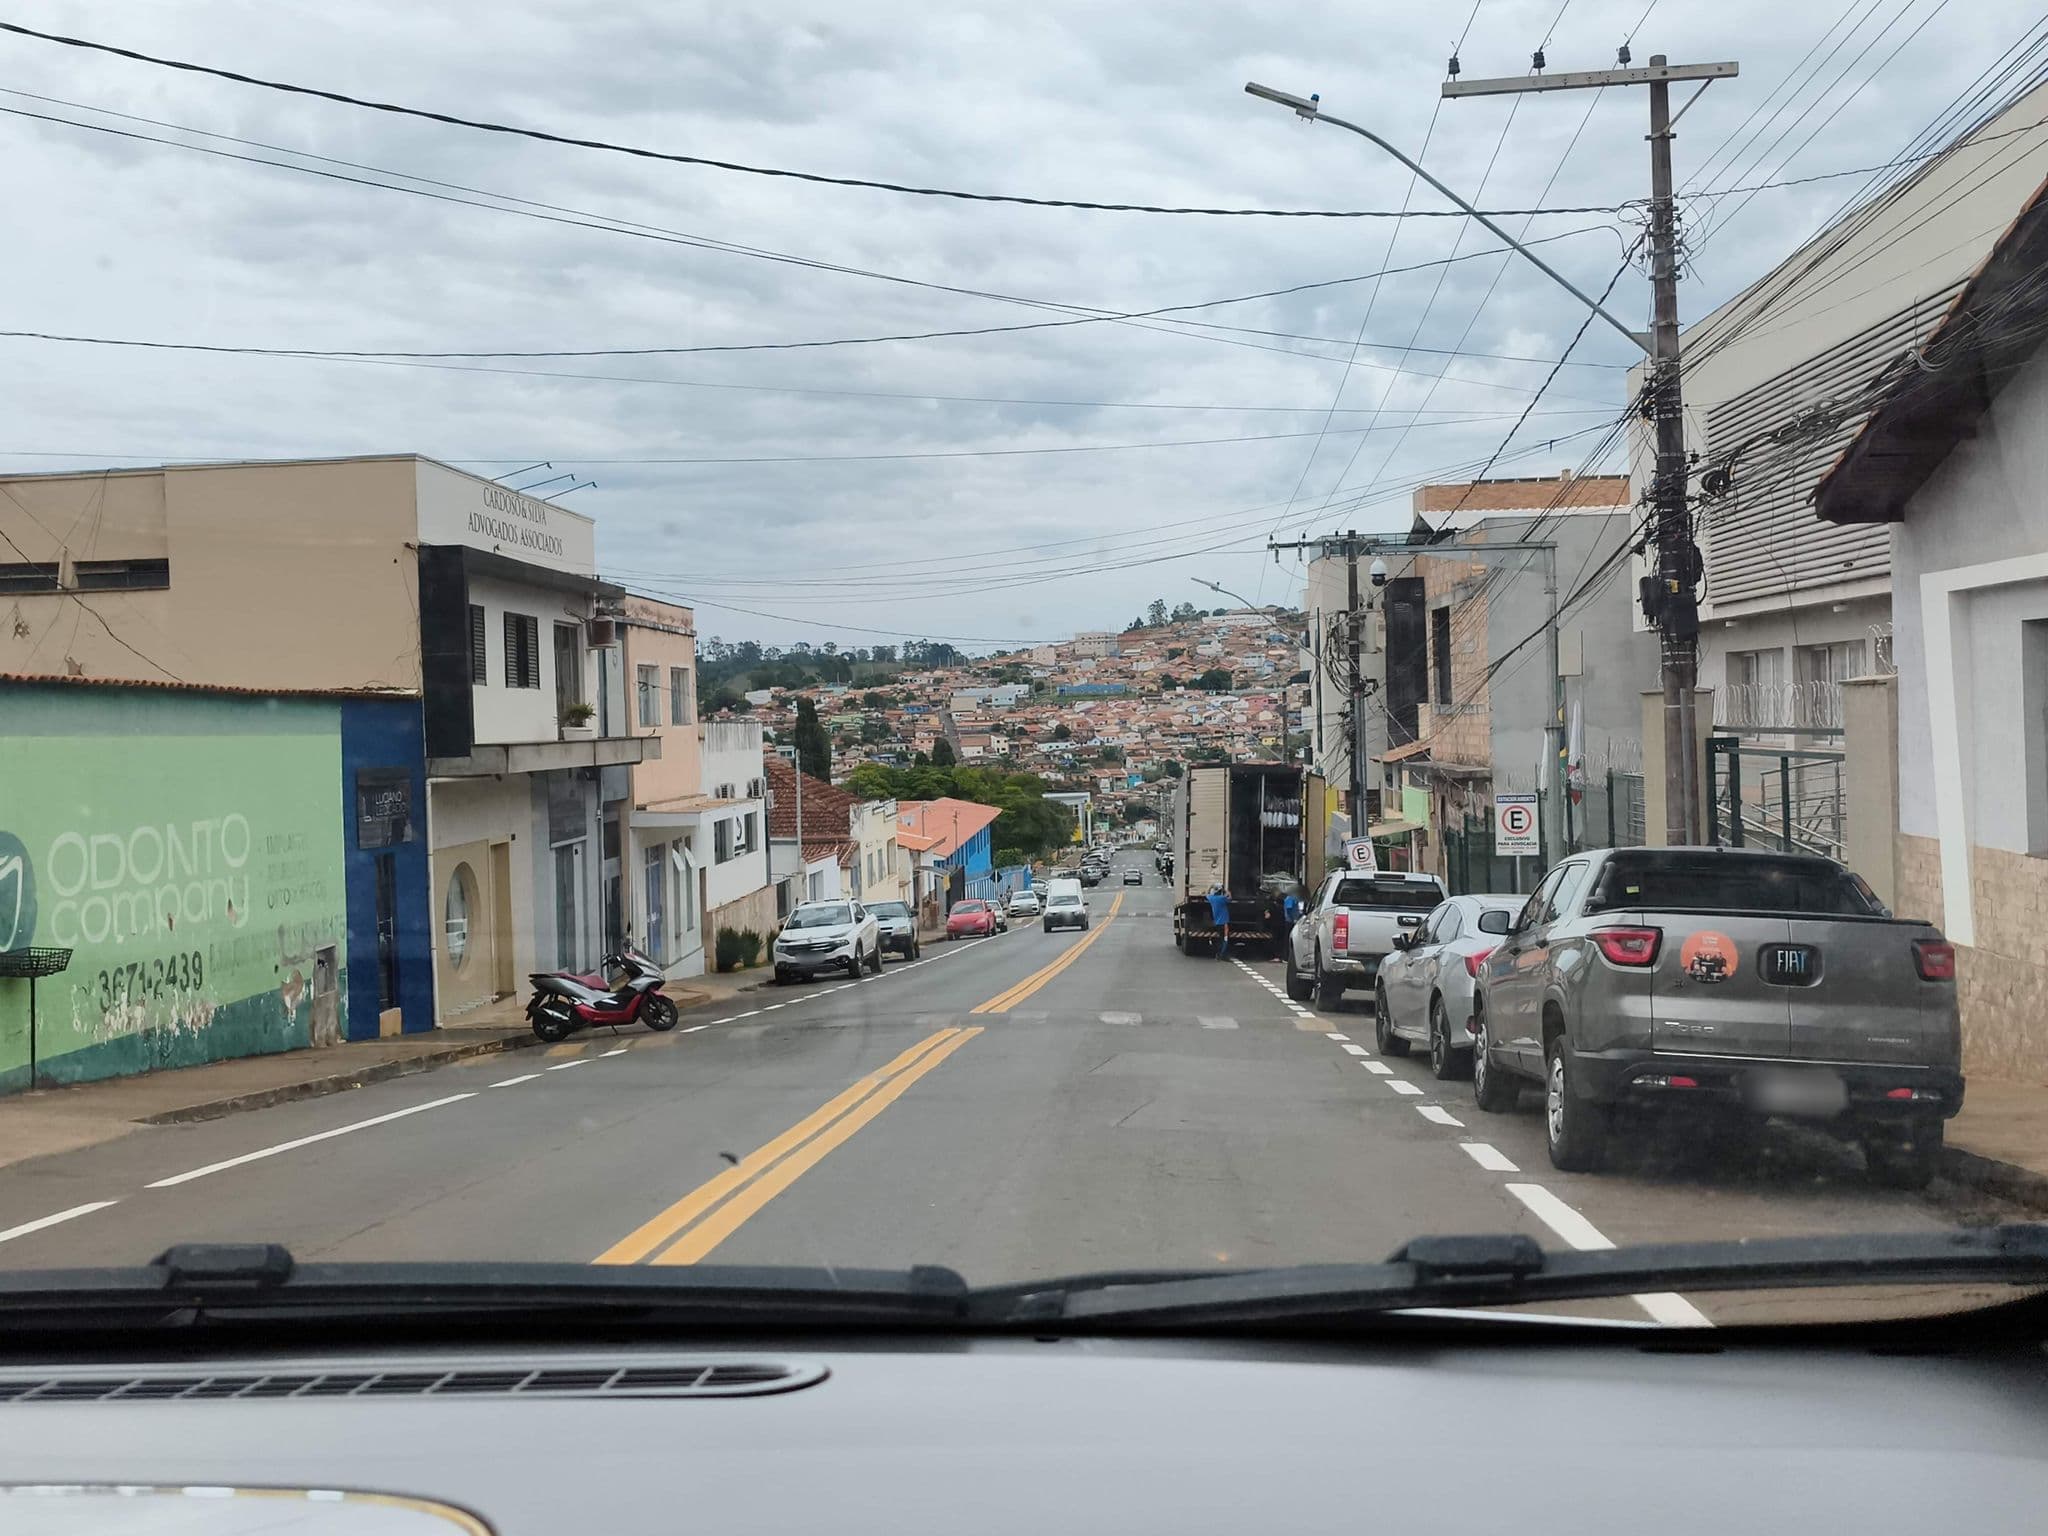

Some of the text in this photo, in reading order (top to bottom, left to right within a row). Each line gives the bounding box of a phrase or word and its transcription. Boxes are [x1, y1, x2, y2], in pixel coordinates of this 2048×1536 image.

[483, 487, 546, 525] CARDOSO & SILVA
[468, 511, 563, 556] ADVOGADOS ASSOCIADOS
[1510, 811, 1523, 829] E
[47, 813, 250, 897] ODONTO
[1357, 847, 1366, 860] E
[51, 875, 249, 946] company
[98, 950, 203, 1013] 3671-2439
[1777, 950, 1808, 973] FIAT
